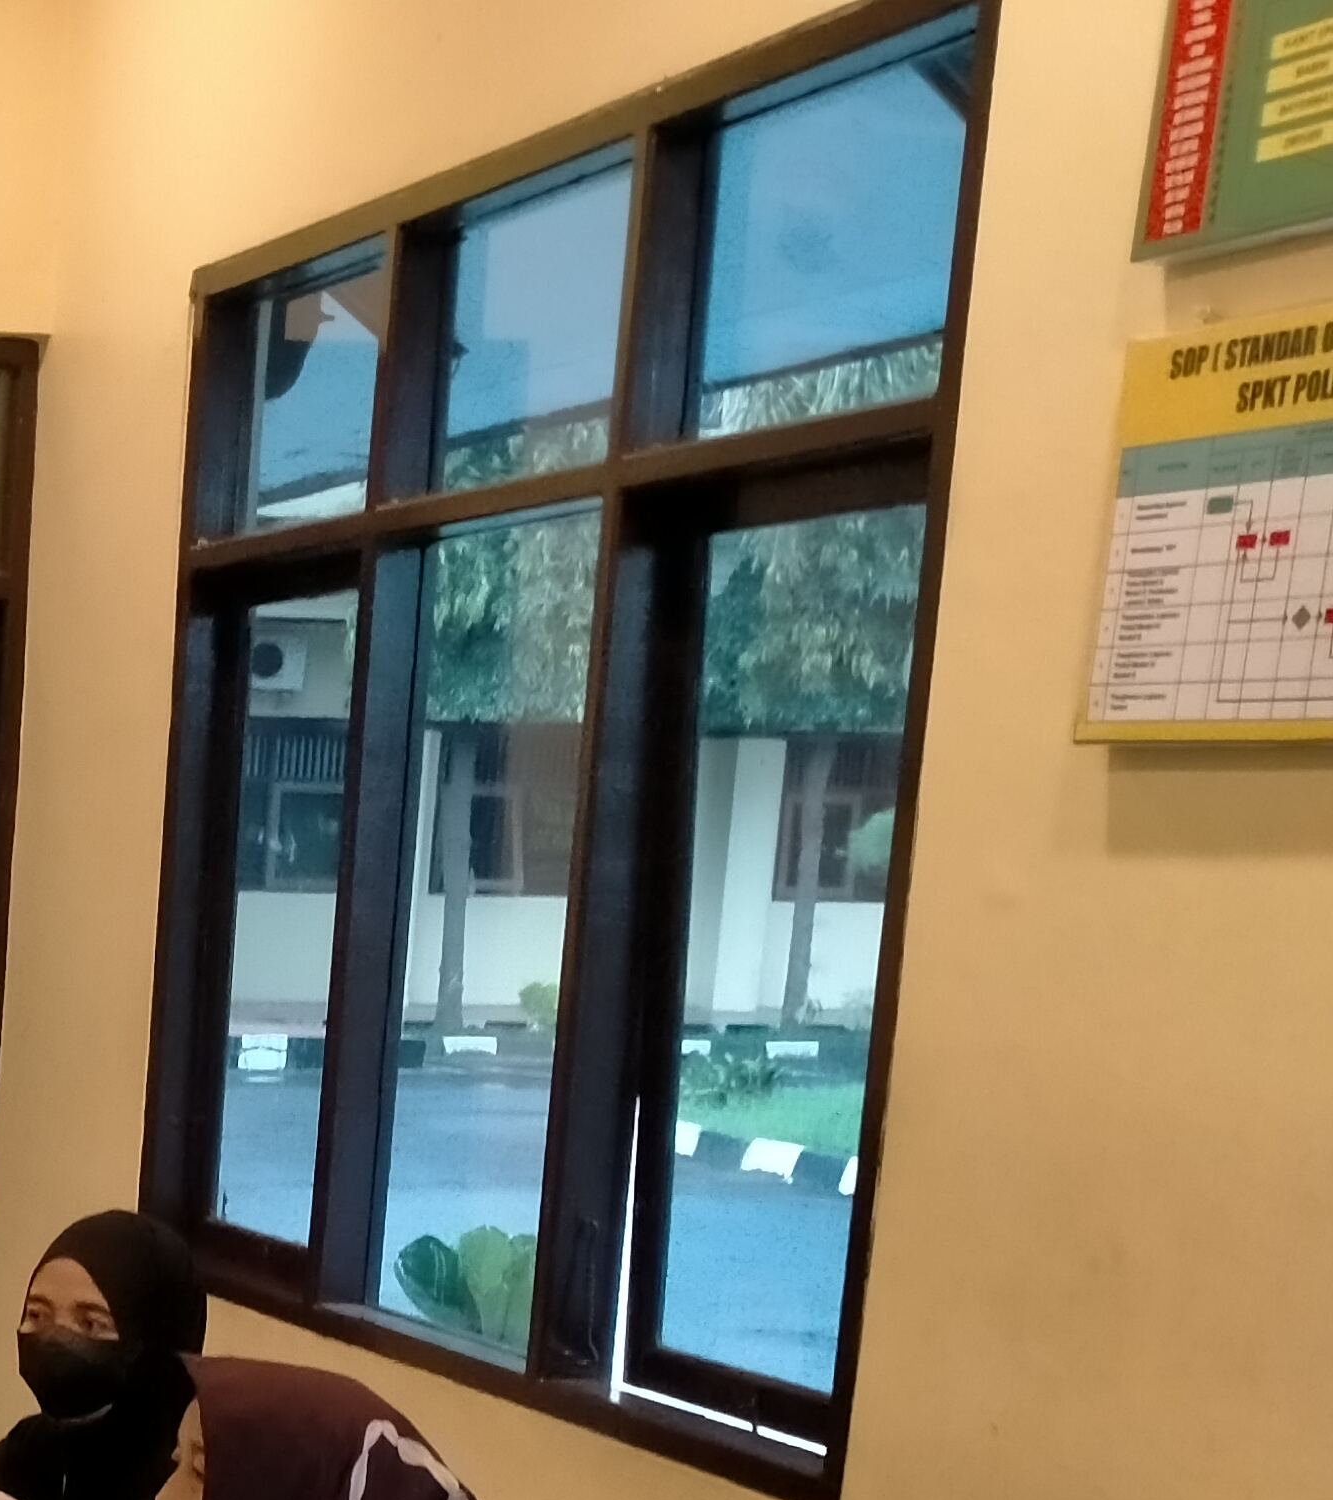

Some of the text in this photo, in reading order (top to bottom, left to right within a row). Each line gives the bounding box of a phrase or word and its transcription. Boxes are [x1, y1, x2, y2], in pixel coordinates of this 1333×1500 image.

[1169, 344, 1210, 380] SOP
[1224, 325, 1318, 371] STANDAR
[1235, 367, 1333, 414] SPKT POL
